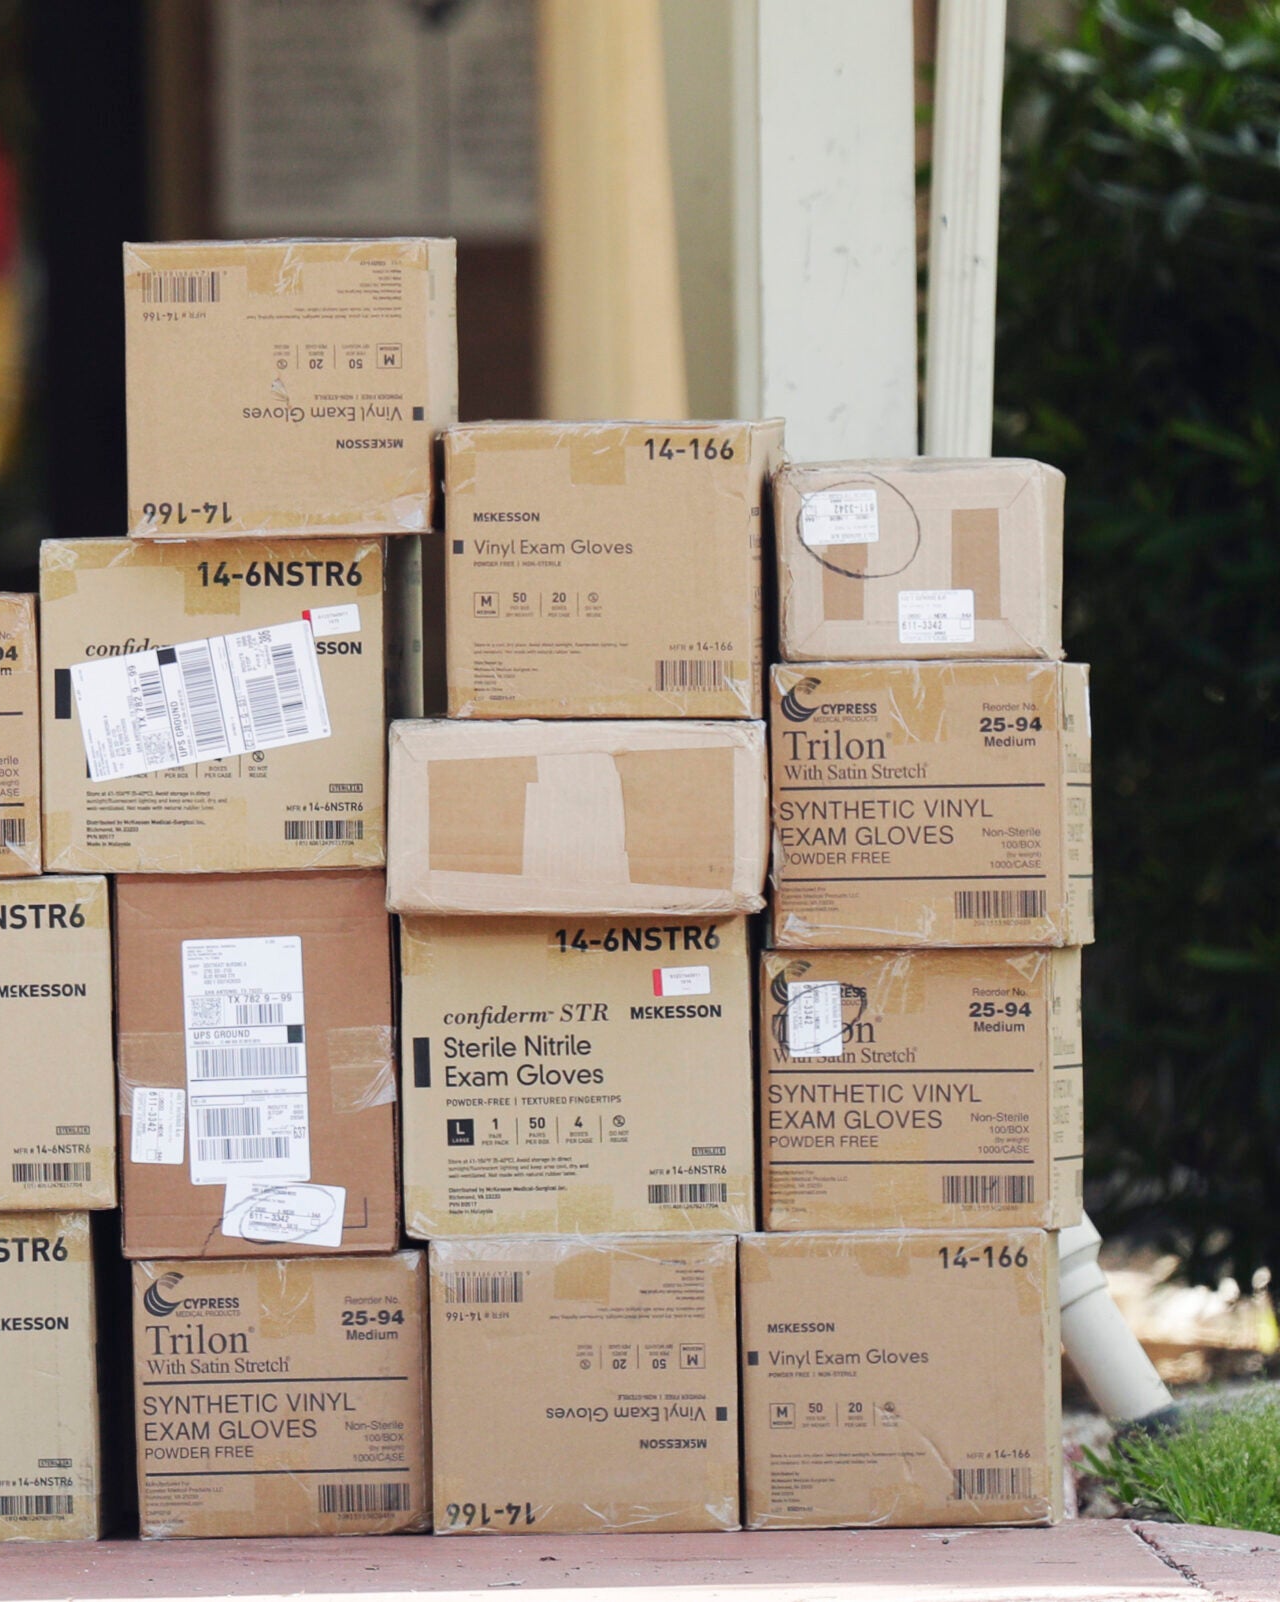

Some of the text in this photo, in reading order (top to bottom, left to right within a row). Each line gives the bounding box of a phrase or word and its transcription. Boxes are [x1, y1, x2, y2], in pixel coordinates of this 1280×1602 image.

[143, 312, 179, 321] 14-166
[309, 358, 323, 370] 20
[349, 358, 363, 369] 50
[242, 403, 402, 423] Vinyl Exam Gloves
[336, 438, 403, 449] McKESSON
[644, 438, 734, 460] 14-166
[143, 502, 232, 524] 14-166
[473, 512, 540, 522] McKESSON
[474, 539, 633, 558] Vinyl Exam Gloves
[198, 561, 362, 587] 14-6NSTR6
[513, 592, 527, 603] 50
[552, 592, 566, 603] 20
[316, 641, 362, 655] SSON
[696, 641, 733, 651] 14-166
[821, 703, 877, 715] CYPRESS
[982, 702, 1020, 712] Reorder
[170, 700, 184, 738] GROUND
[979, 717, 1042, 732] 25-94
[783, 729, 886, 760] Trilon
[984, 736, 1036, 747] Medium
[784, 763, 927, 780] With Satin Stretch
[309, 802, 363, 812] 14-6NSTR6
[779, 799, 993, 821] SYNTHETIC VINYL
[779, 825, 954, 848] EXAM GLOVES
[981, 826, 1041, 837] Non-Sterile
[1001, 839, 1042, 849] 100/BOX
[782, 851, 891, 867] POWDER FREE
[990, 859, 1041, 869] 1000/CASE
[554, 923, 721, 953] 14-6NSTR6
[972, 987, 1010, 997] Reorder
[969, 1002, 1032, 1018] 25-94
[443, 1003, 722, 1030] confiderm STR McKESSON
[973, 1021, 1025, 1032] Medium
[193, 1030, 250, 1040] UPS GROUND
[444, 1034, 591, 1058] Sterile Nitrile
[861, 1047, 916, 1064] Stretch
[445, 1064, 604, 1087] Exam Gloves
[768, 1084, 982, 1104] SYNTHETIC VINYL
[446, 1095, 622, 1107] POWDER-FREE TEXTURED FINGERTIPS
[529, 1117, 546, 1129] 50
[769, 1109, 942, 1130] EXAM GLOVES
[970, 1112, 1029, 1123] Non-Sterile
[989, 1125, 1030, 1134] 100/BOX
[769, 1135, 878, 1148] POWDER FREE
[36, 1144, 91, 1154] 14-6NSTR6
[978, 1145, 1030, 1154] 1000/CASE
[672, 1165, 727, 1175] 14-6NSTR6
[939, 1245, 1028, 1269] 14-166
[183, 1297, 239, 1312] CYPRESS
[341, 1310, 405, 1326] 25-94
[446, 1312, 482, 1321] 14-166
[767, 1322, 835, 1333] McKESSON
[145, 1324, 251, 1355] Trilon
[346, 1329, 398, 1340] Medium
[612, 1358, 627, 1370] 20
[652, 1358, 667, 1369] 50
[768, 1348, 929, 1369] Vinyl Exam Gloves
[147, 1356, 289, 1375] With Satin Stretch
[143, 1392, 356, 1416] SYNTHETIC VINYL
[808, 1402, 823, 1413] 50
[848, 1402, 863, 1413] 20
[546, 1403, 706, 1422] Vinyl Exam Gloves
[144, 1418, 317, 1441] EXAM GLOVES
[345, 1420, 404, 1431] Non-Sterile
[364, 1432, 404, 1442] 100/BOX
[640, 1438, 707, 1449] McKESSON
[145, 1445, 254, 1460] POWDER FREE
[353, 1452, 405, 1463] 1000/CASE
[994, 1449, 1031, 1459] 14-166
[18, 1476, 73, 1487] 14-6NSTR6
[446, 1502, 536, 1527] 14-166
